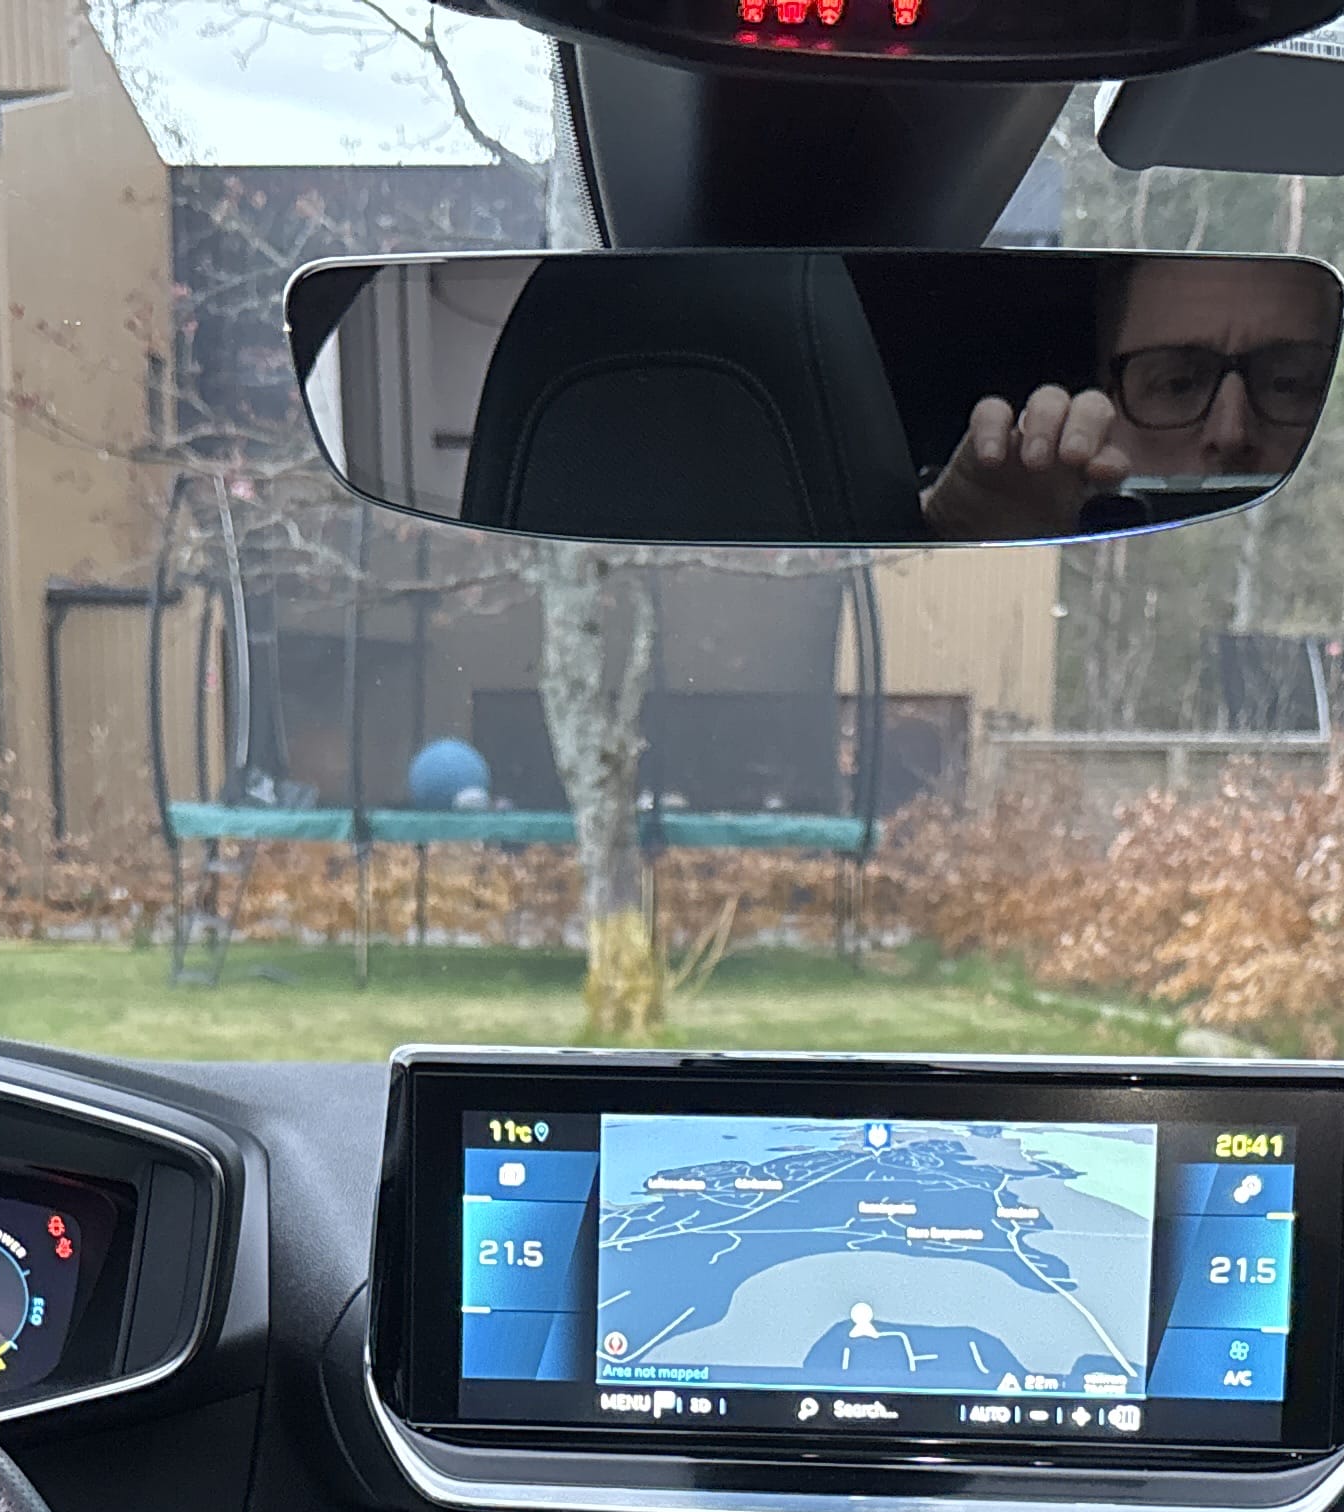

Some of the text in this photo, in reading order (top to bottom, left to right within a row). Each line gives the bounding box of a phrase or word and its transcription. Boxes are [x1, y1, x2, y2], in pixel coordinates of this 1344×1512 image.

[1215, 1134, 1284, 1158] 20:41
[478, 1240, 544, 1267] 21.5
[1209, 1256, 1276, 1284] 21.5
[31, 1298, 44, 1325] ECO
[602, 1363, 709, 1381] Area not mapped
[1223, 1370, 1253, 1387] A/C
[601, 1393, 651, 1412] MENU
[969, 1405, 1011, 1424] AUTO
